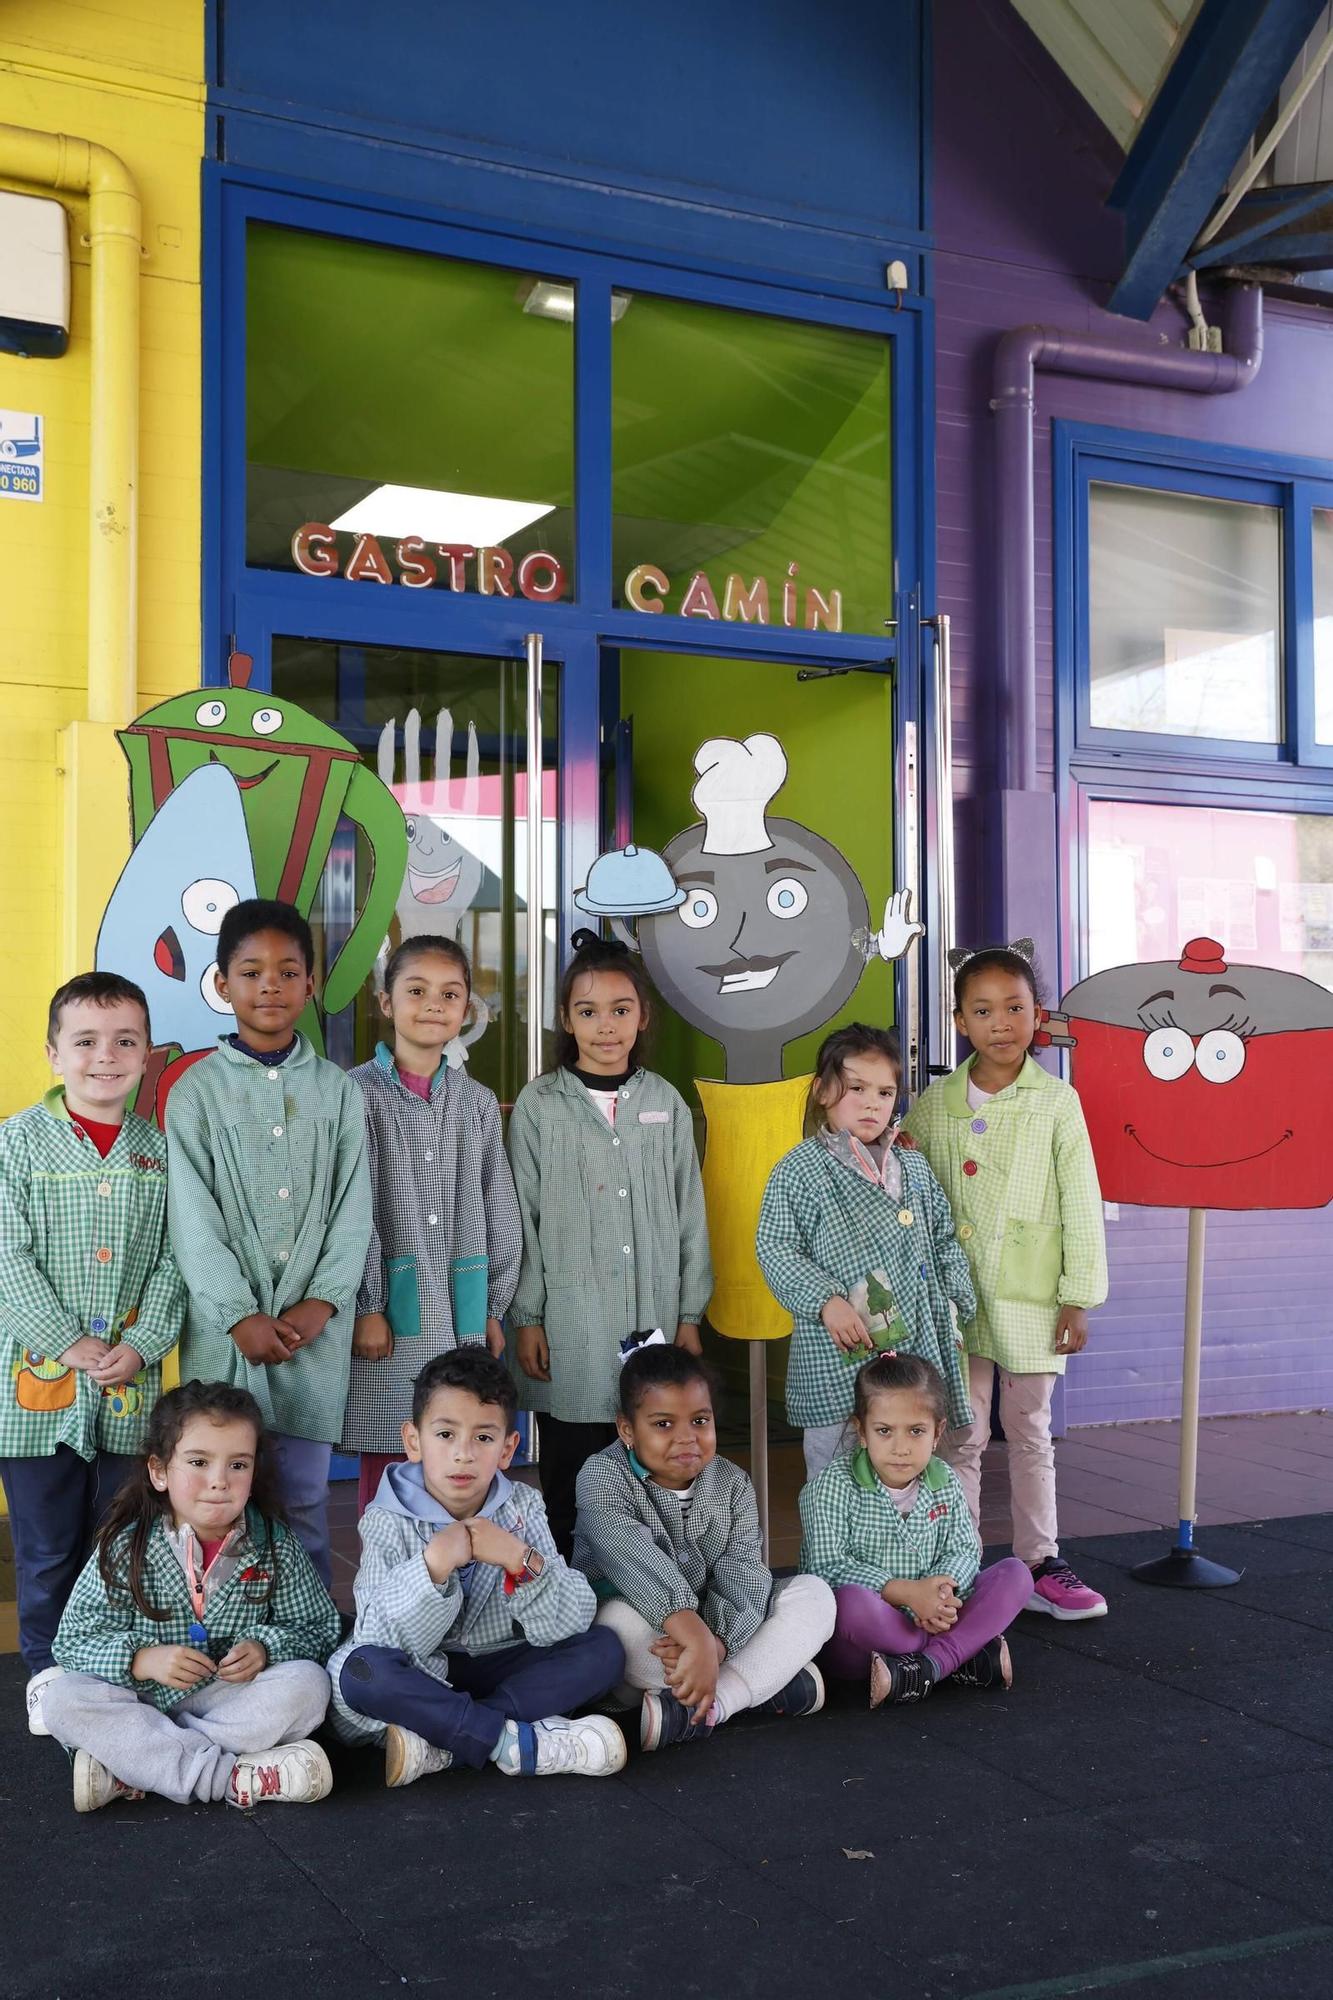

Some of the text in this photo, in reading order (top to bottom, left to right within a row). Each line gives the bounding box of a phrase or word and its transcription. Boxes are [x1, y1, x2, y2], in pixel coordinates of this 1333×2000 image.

[0, 463, 36, 477] NECTADA
[0, 475, 37, 492] 0 960
[291, 522, 565, 602] GASTRO
